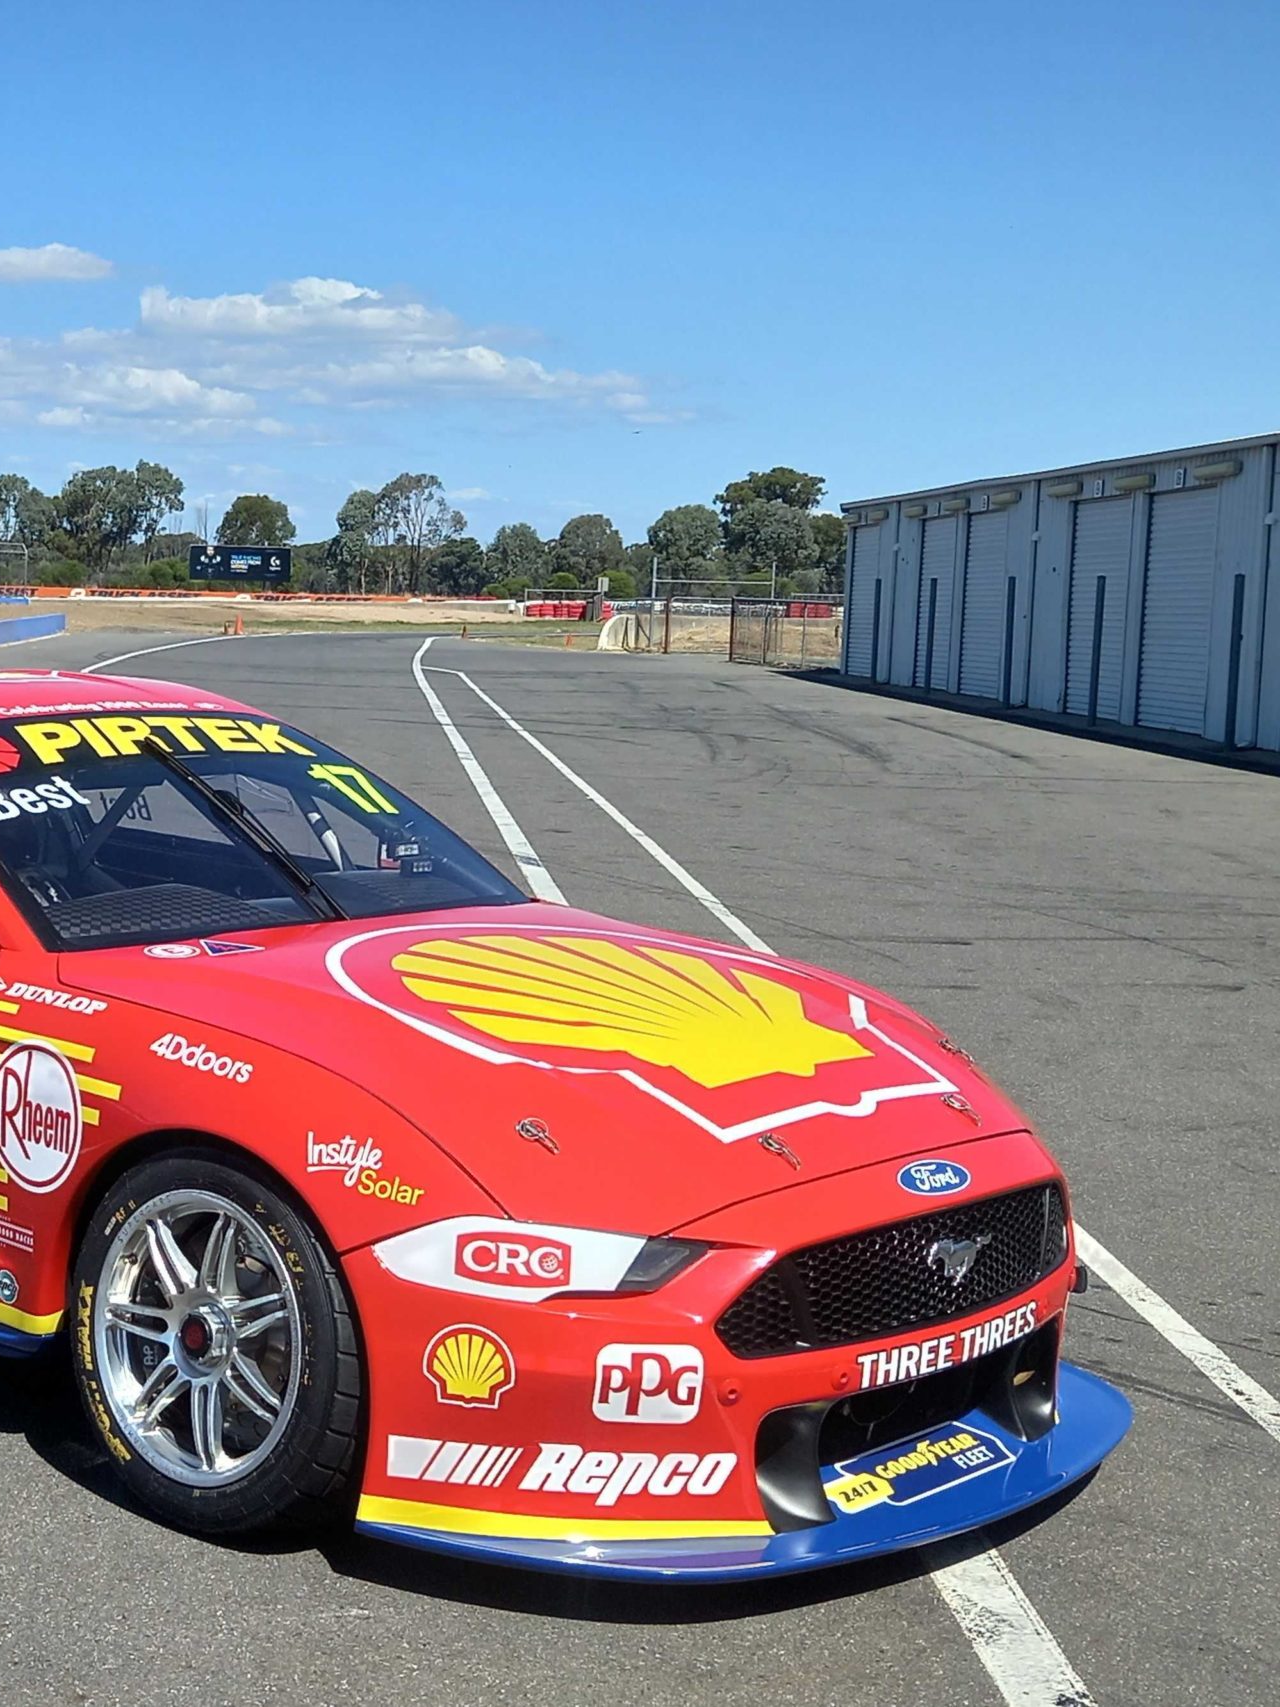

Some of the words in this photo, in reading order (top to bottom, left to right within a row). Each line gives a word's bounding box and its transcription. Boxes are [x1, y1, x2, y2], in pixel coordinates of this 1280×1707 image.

[89, 589, 142, 599] TRUCK
[147, 591, 202, 599] ASSIST
[14, 716, 317, 765] PIRTEK
[307, 763, 400, 814] 17
[5, 982, 108, 1015] DUNLOP
[149, 1033, 254, 1084] 4Ddoors
[0, 1050, 71, 1161] Rheem
[307, 1131, 383, 1187] Instyle
[910, 1164, 960, 1191] Ford
[357, 1168, 425, 1206] Solar
[462, 1239, 564, 1279] CRC
[857, 1334, 956, 1389] THREE
[959, 1301, 1037, 1362] THREES
[597, 1352, 699, 1416] PPG
[517, 1442, 738, 1506] Repco
[838, 1480, 879, 1504] 24/7
[875, 1432, 981, 1480] GOODYEAR
[952, 1445, 995, 1470] FLEET
